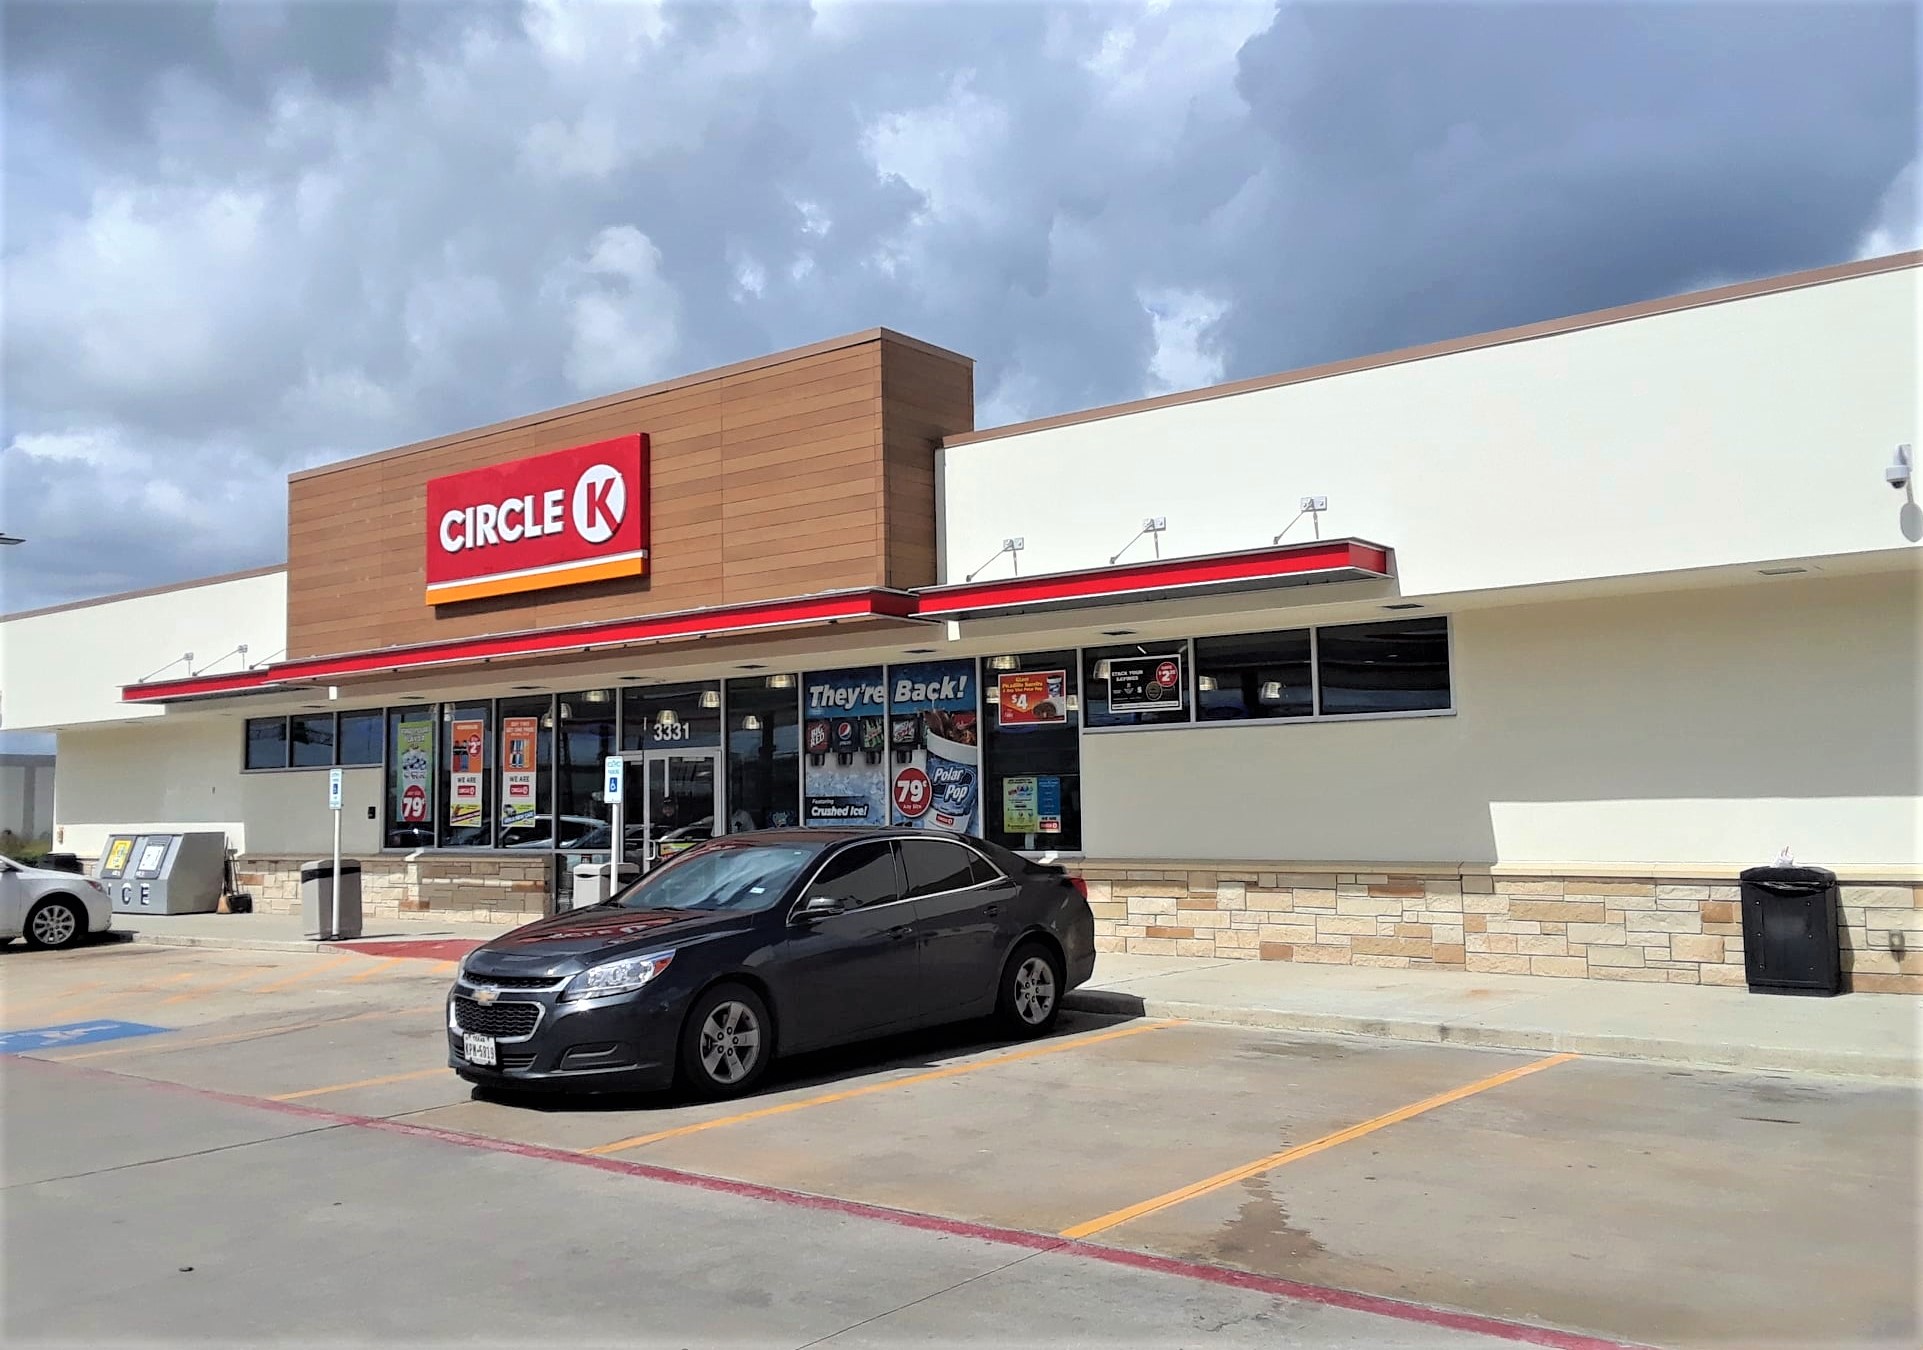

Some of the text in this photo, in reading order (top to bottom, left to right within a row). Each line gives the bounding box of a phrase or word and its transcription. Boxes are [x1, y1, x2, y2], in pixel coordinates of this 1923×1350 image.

[440, 468, 626, 553] CIRCLE K
[809, 675, 968, 710] They're Back!
[1011, 693, 1029, 710] $4
[653, 722, 690, 741] 3331
[811, 731, 827, 749] RED
[934, 767, 965, 783] Polar
[897, 780, 928, 803] 79¢
[945, 784, 968, 804] Pop
[811, 804, 869, 818] Crushed Ice!
